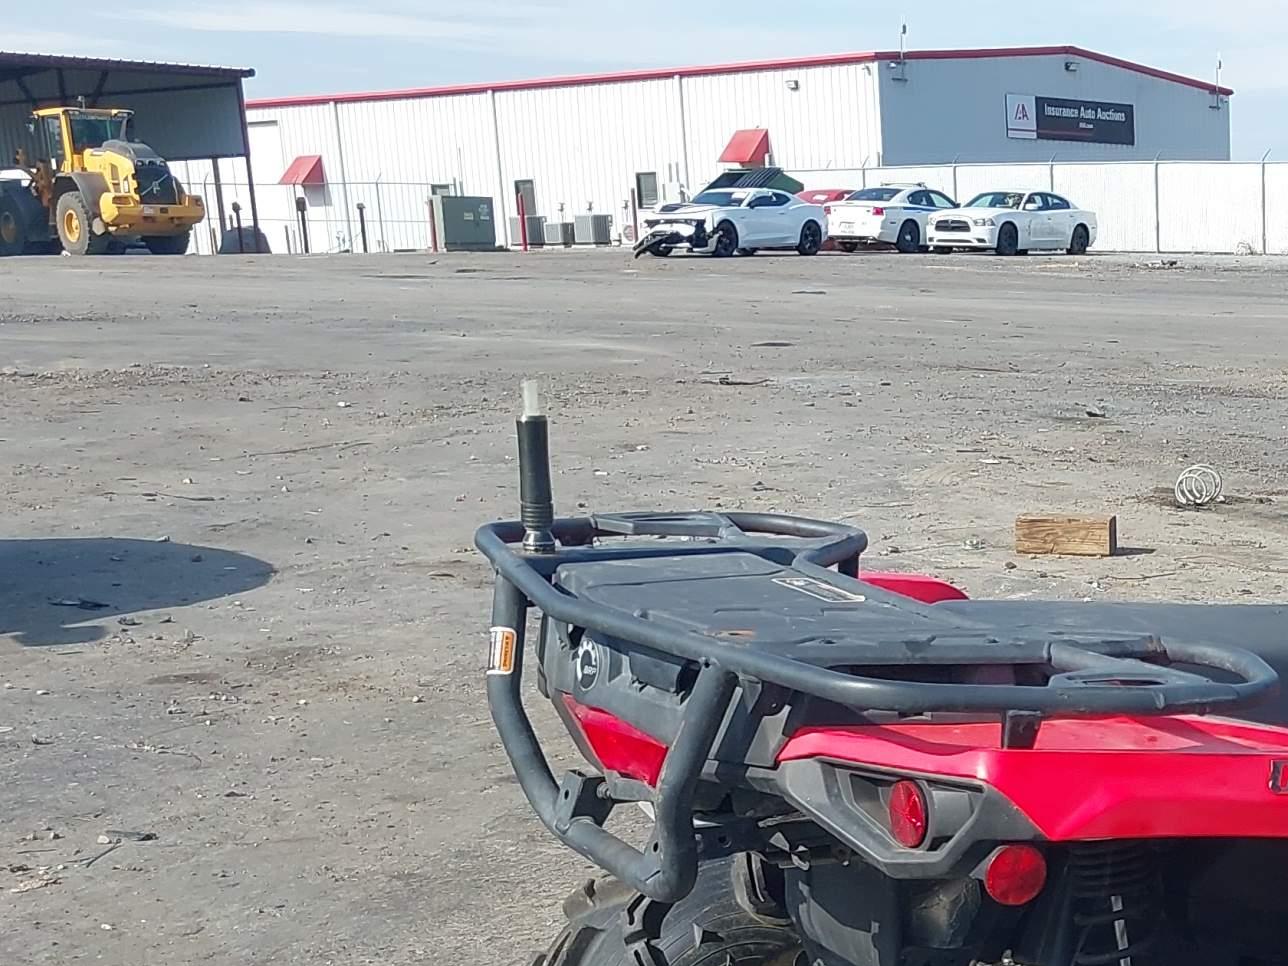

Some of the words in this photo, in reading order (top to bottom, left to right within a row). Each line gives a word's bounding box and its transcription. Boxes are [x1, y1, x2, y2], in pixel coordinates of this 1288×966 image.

[1044, 103, 1078, 118] Insurance
[1080, 106, 1095, 120] Auto
[1097, 107, 1126, 122] Auctions
